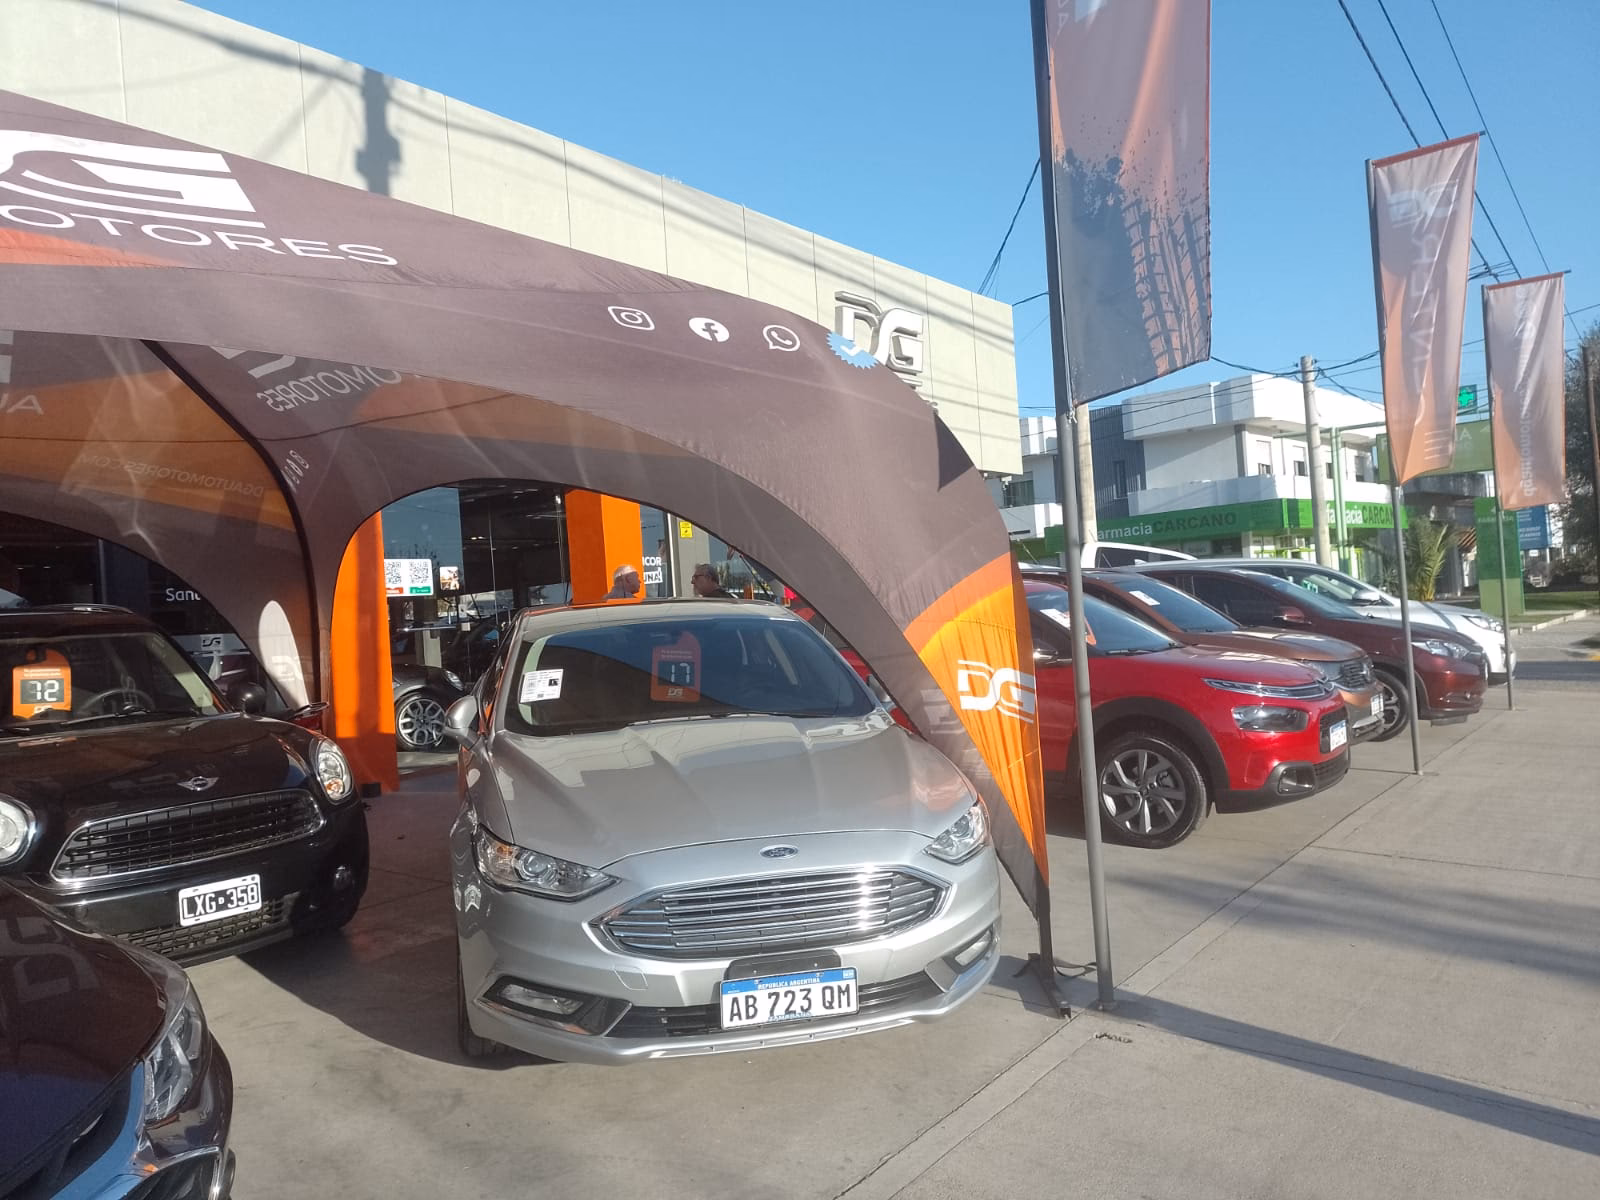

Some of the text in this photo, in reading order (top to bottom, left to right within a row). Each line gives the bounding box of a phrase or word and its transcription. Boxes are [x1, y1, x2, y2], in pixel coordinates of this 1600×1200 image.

[1097, 511, 1237, 540] armacia CARCANO
[29, 679, 60, 702] 72
[957, 659, 1035, 724] DG
[729, 983, 851, 1022] AB 723 QM
